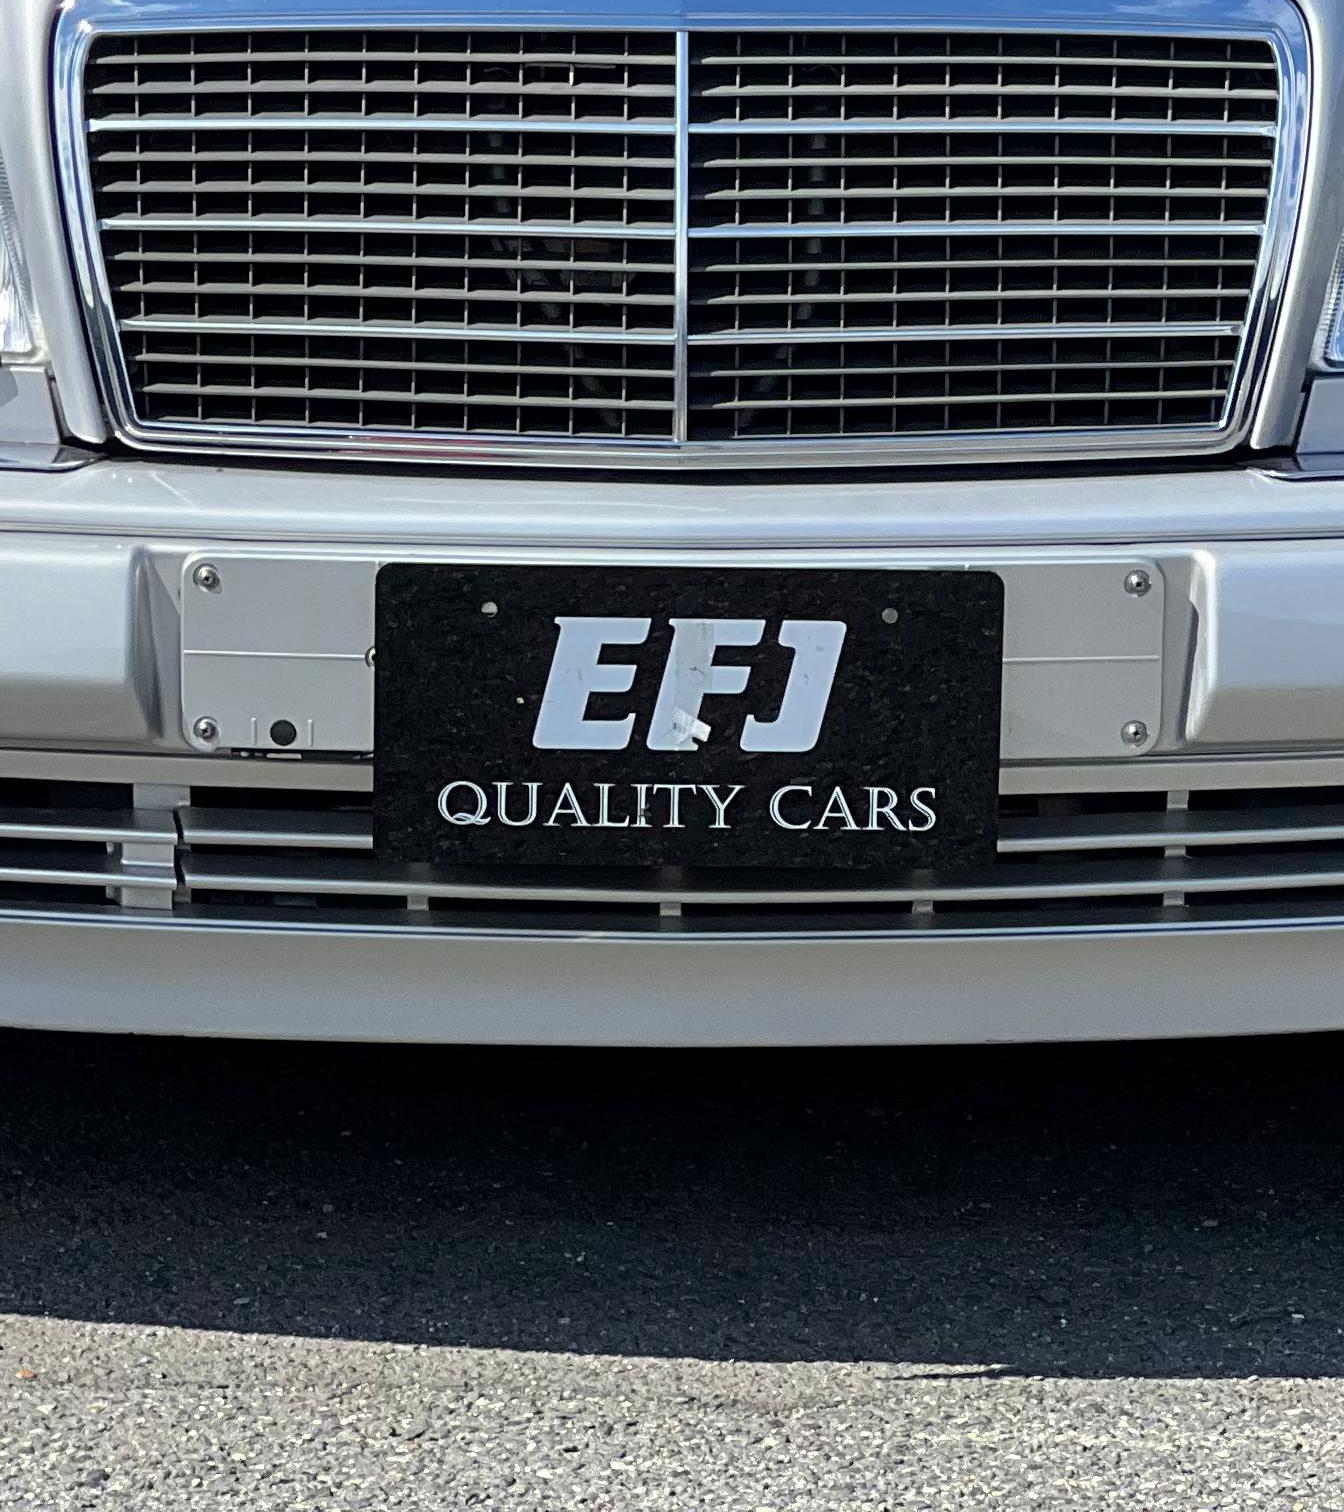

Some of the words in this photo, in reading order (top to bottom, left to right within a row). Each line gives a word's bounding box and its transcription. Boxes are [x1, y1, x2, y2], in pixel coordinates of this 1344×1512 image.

[532, 616, 847, 752] EFJ
[437, 780, 745, 829] QUALITY
[769, 785, 937, 832] CARS
